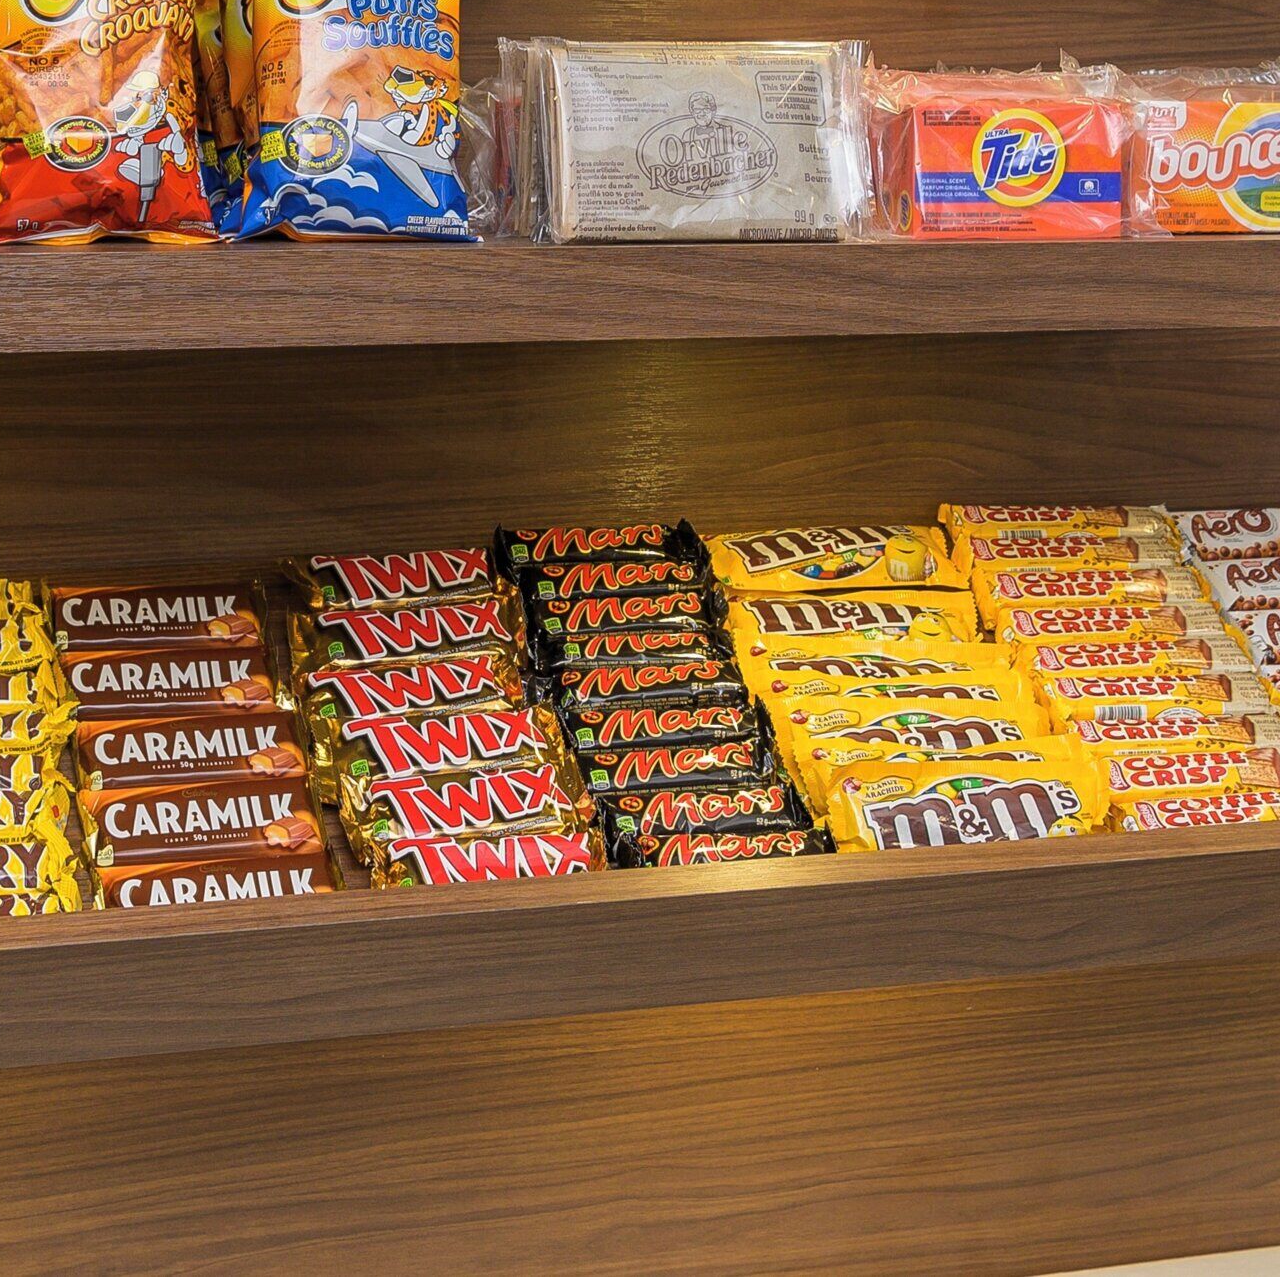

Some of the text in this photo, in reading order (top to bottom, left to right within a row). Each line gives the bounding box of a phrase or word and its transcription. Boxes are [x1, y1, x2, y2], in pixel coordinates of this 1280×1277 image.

[80, 2, 193, 57] CROQUANT
[321, 15, 454, 60] Soufflés
[659, 126, 749, 167] Orville
[984, 129, 1010, 139] ULTRA
[650, 146, 774, 190] Redenbacher
[980, 132, 1058, 190] Tide
[739, 228, 782, 240] MICROWAVE
[789, 228, 838, 240] MICRO-ONDES
[794, 210, 815, 225] 99 g
[559, 562, 694, 598] Mars
[1019, 570, 1133, 584] COFFEE
[1022, 581, 1113, 598] CRISP
[62, 596, 237, 626] CARAMILK
[319, 600, 512, 660] TWIX
[71, 659, 250, 693] CARAMILK
[342, 708, 549, 778] TWIX
[599, 706, 743, 746] Mars
[1123, 751, 1248, 771] COFFEE
[1129, 766, 1228, 787] CRISP
[369, 764, 572, 840] TWIX
[865, 779, 898, 792] PEANUT
[865, 785, 906, 800] ARACHIDE
[104, 793, 293, 839] CARAMILK
[640, 786, 784, 835] Mars
